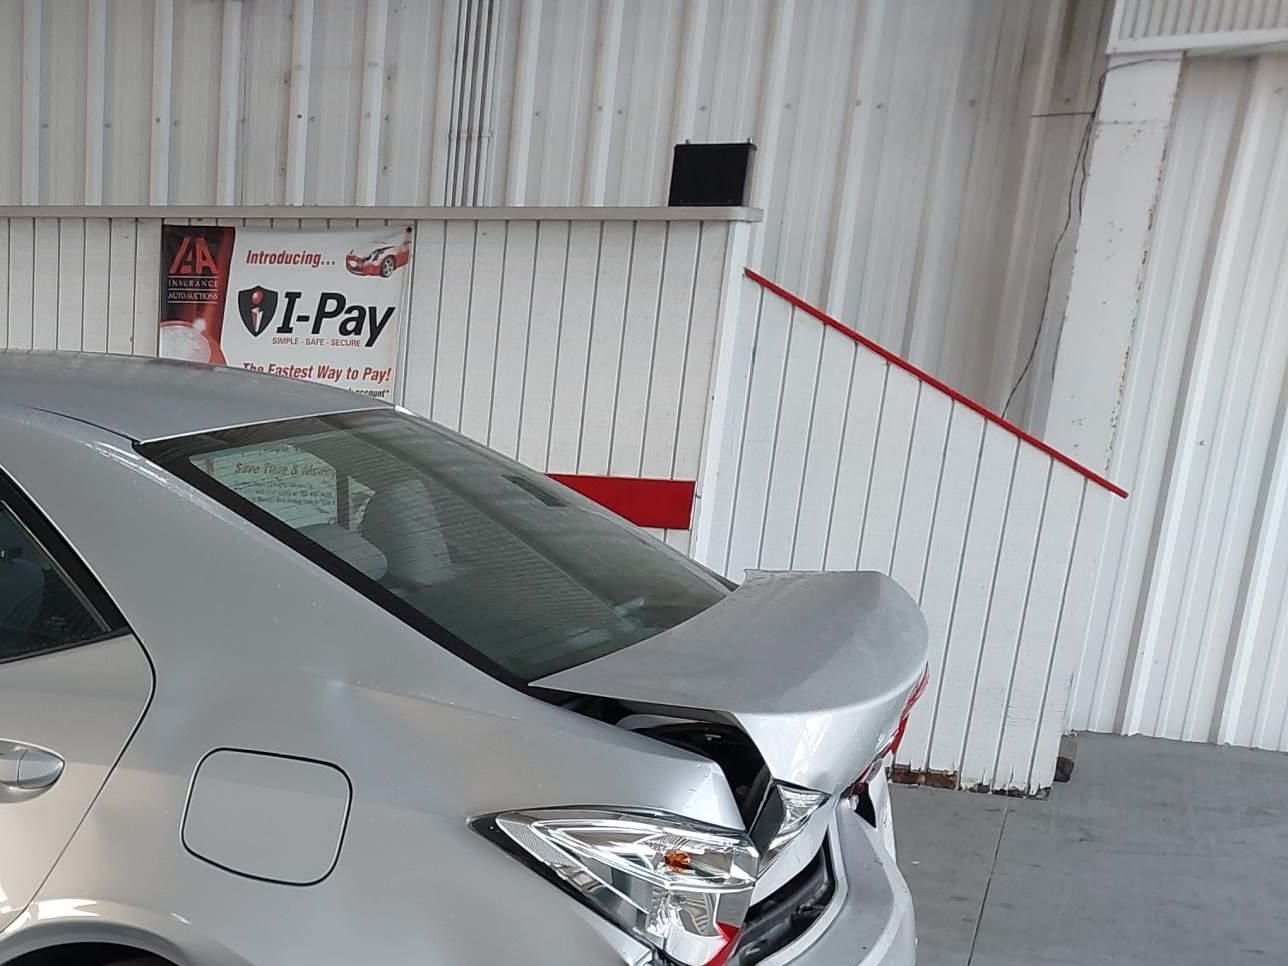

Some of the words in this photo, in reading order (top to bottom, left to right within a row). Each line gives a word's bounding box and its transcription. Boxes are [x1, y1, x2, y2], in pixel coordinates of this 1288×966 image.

[246, 250, 336, 268] Introducing...
[168, 279, 218, 288] INSURANCE
[276, 291, 396, 347] I-Pay
[272, 337, 298, 345] SIMPLE
[305, 337, 325, 346] SAFE
[330, 338, 361, 347] SECURE
[268, 363, 314, 379] Fastest
[317, 365, 342, 383] Way
[346, 367, 359, 380] to
[362, 367, 392, 384] Pay!
[234, 462, 261, 474] Save
